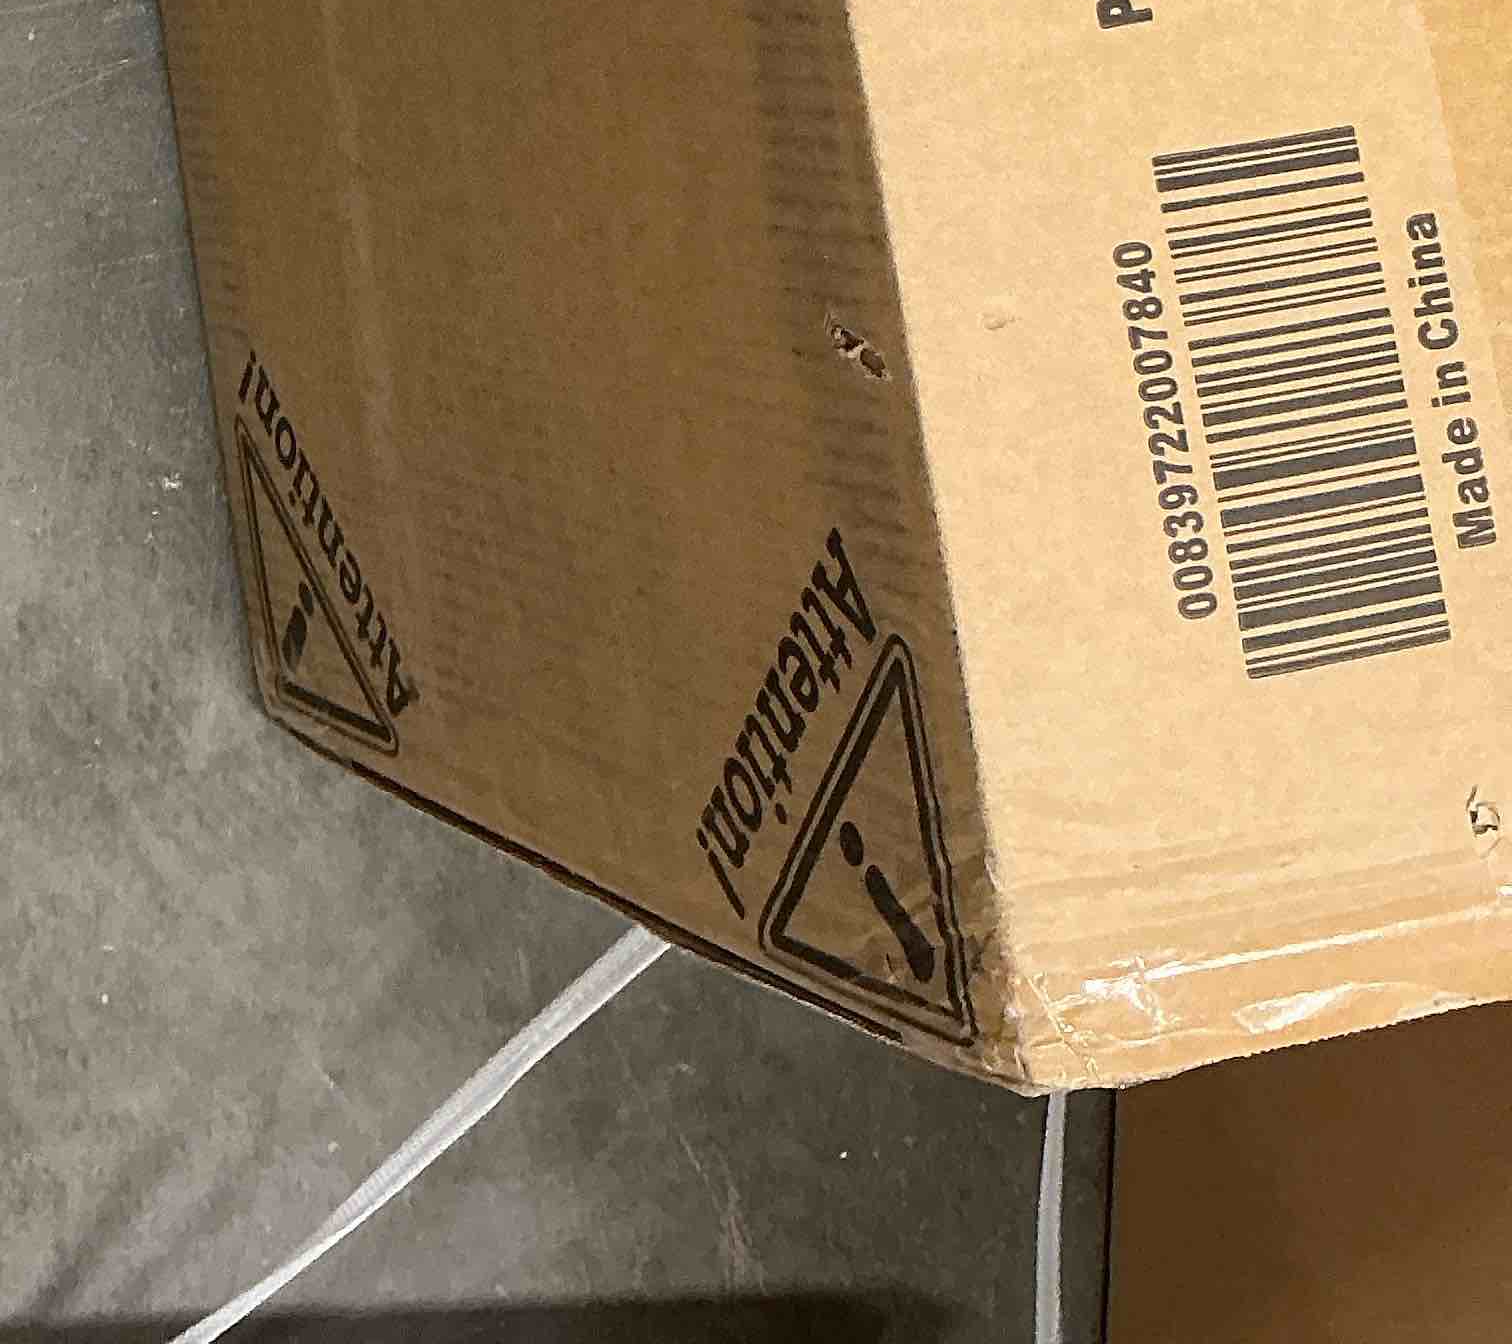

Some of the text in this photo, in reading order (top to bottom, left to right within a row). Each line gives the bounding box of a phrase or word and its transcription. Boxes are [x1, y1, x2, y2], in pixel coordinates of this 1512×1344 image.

[237, 350, 420, 716] Attention!
[1113, 241, 1218, 620] 00839722007840
[1406, 212, 1497, 551] Made in China
[696, 527, 877, 921] Attention!
